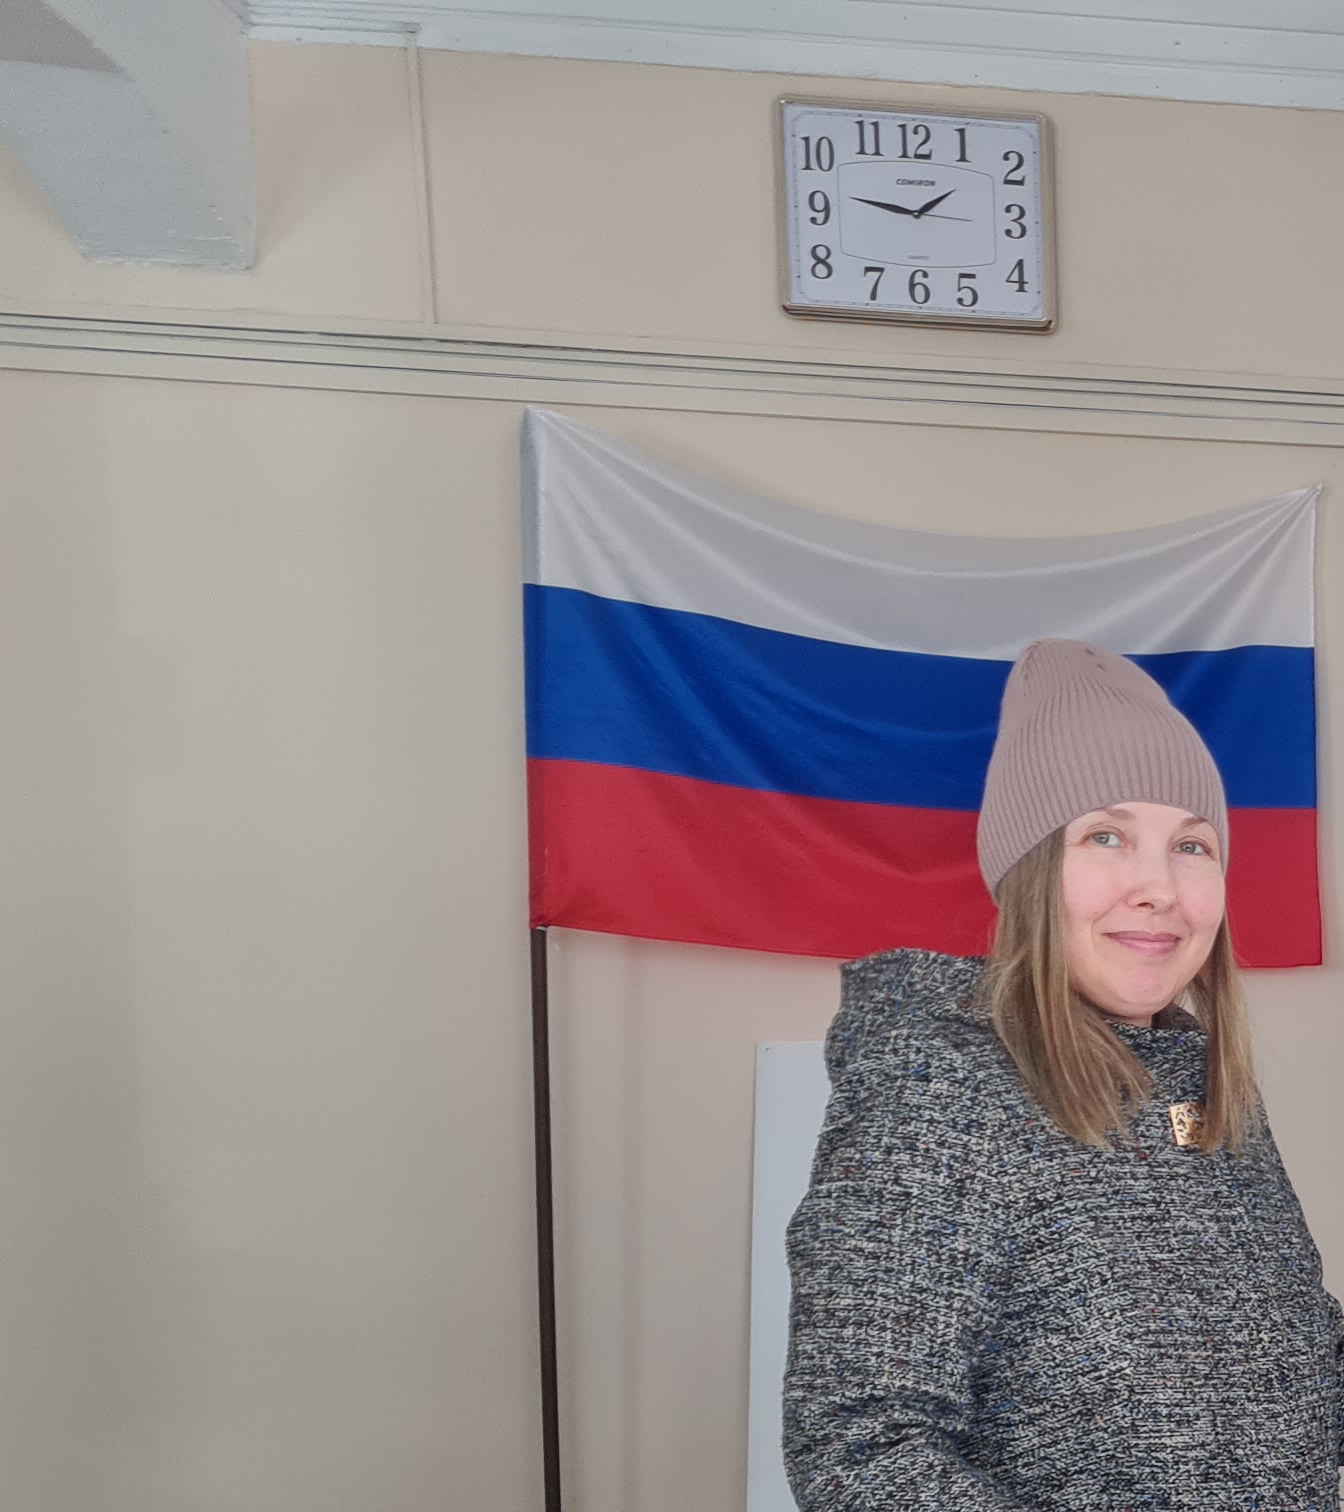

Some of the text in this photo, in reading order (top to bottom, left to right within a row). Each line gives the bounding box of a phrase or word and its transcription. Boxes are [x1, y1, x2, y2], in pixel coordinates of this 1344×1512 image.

[800, 136, 835, 172] 10
[855, 120, 884, 156] 11
[897, 124, 933, 160] 12
[954, 128, 972, 163] 1
[1002, 150, 1026, 186] 2
[808, 190, 831, 225] 9
[1003, 203, 1027, 239] 3
[810, 244, 833, 279] 8
[1005, 258, 1029, 293] 4
[863, 266, 885, 301] 7
[908, 269, 931, 304] 6
[956, 272, 979, 307] 5
